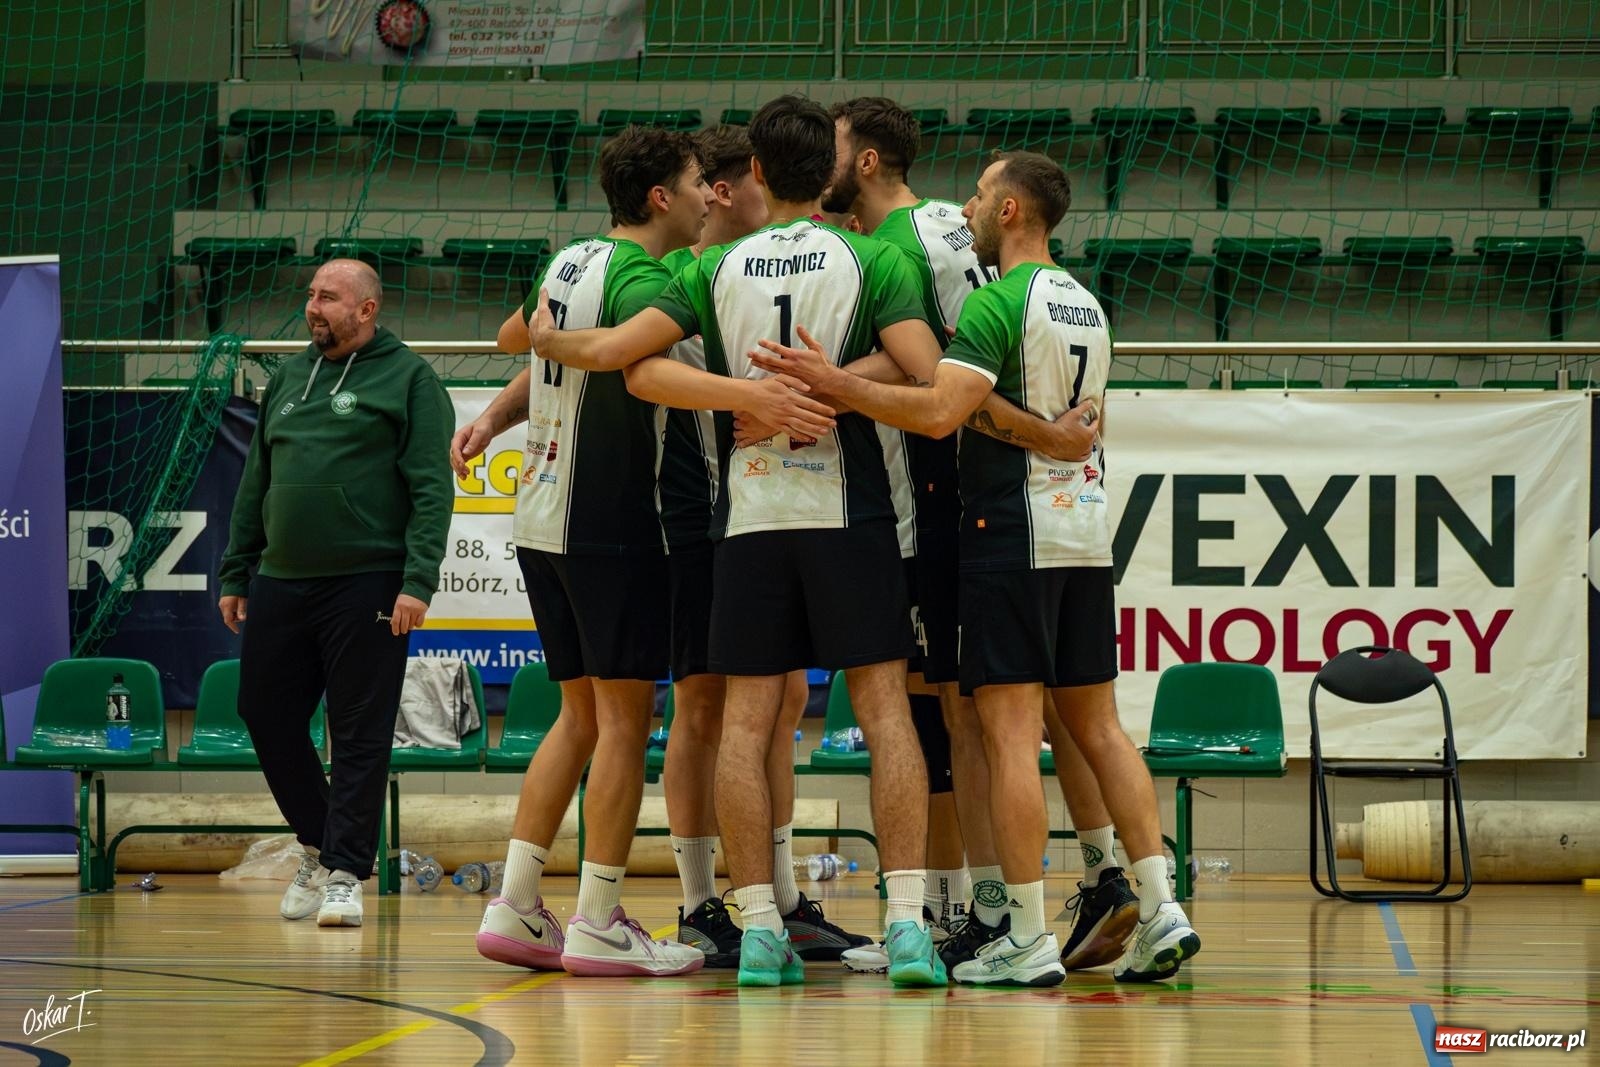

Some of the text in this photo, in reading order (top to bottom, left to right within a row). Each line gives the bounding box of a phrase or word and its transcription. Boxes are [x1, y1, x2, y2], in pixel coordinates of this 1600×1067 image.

[449, 31, 467, 41] tel.
[471, 31, 494, 41] 032
[744, 251, 827, 278] KRETOWICZ
[773, 294, 791, 360] 1
[1069, 344, 1089, 408] 7
[456, 539, 490, 562] 88,
[435, 571, 509, 595] ibórz,
